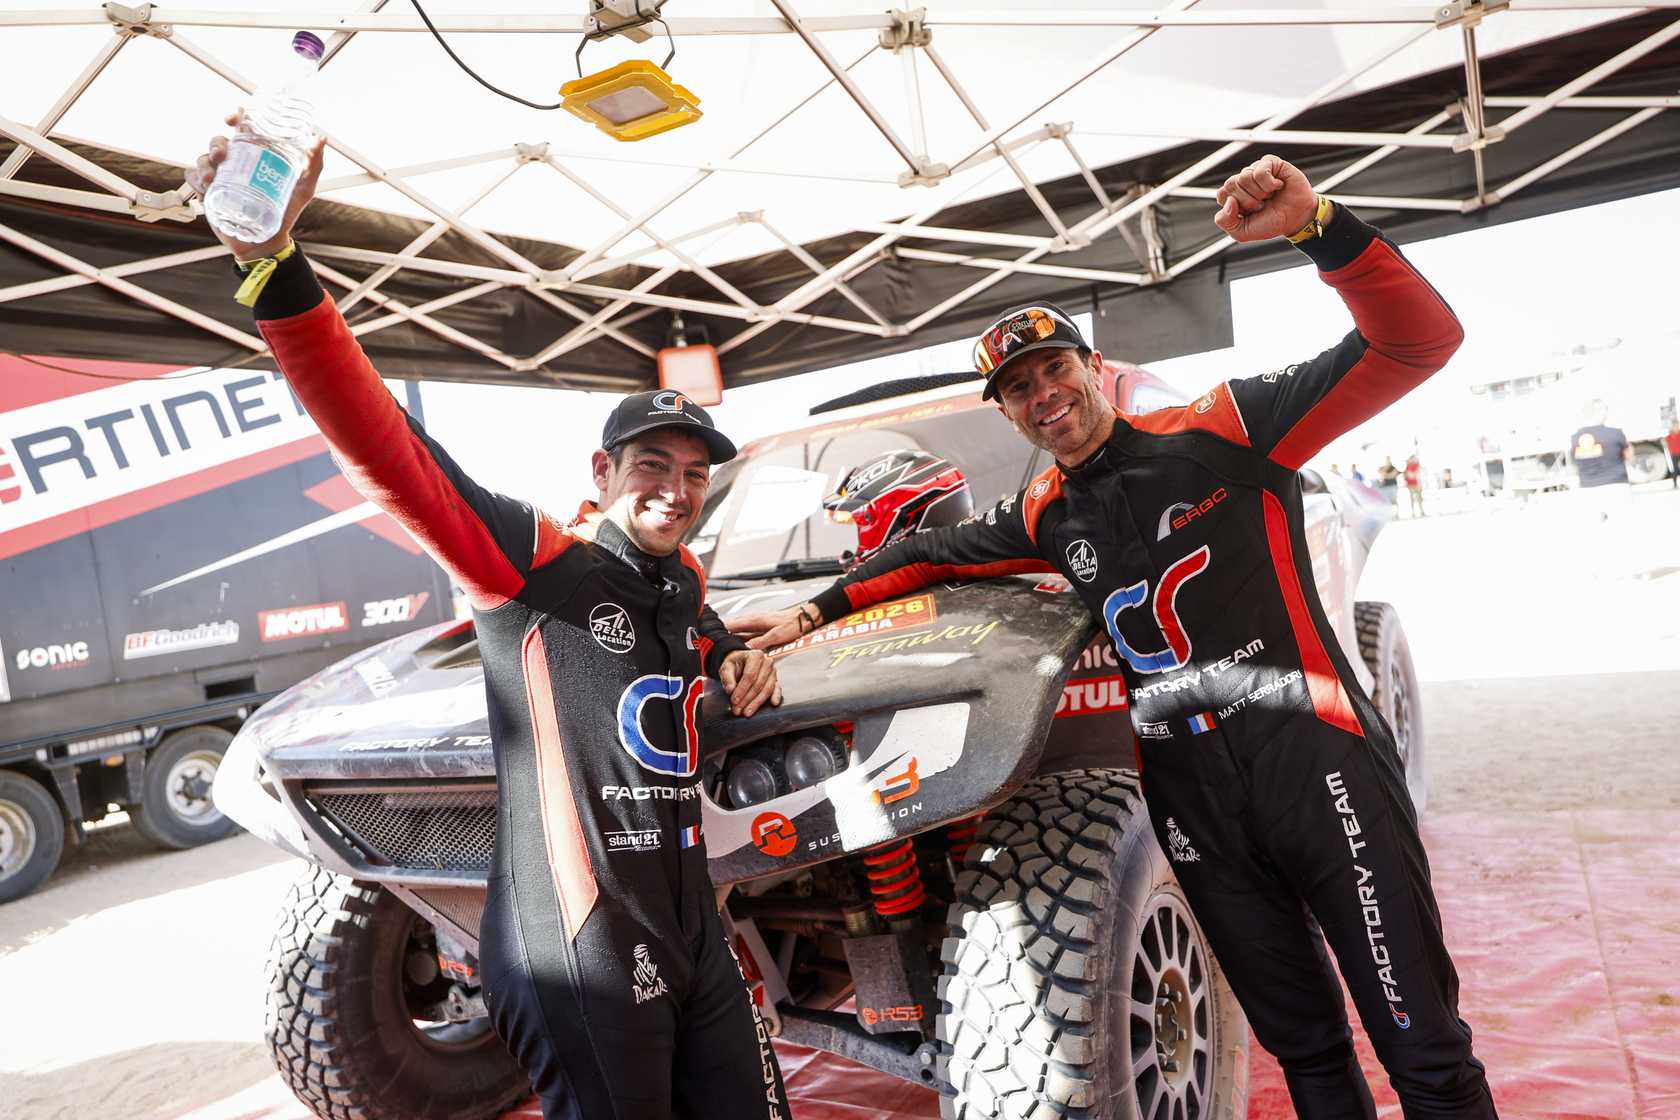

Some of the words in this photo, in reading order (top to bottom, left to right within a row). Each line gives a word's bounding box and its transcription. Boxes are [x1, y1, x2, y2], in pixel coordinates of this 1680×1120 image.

[1173, 487, 1228, 529] ERGO
[265, 606, 345, 638] MOTUL
[593, 623, 634, 641] DELTA
[810, 618, 894, 645] ARABIA
[846, 601, 925, 627] 2026
[1202, 638, 1265, 678] TEAM
[1217, 697, 1246, 720] MATT
[1247, 669, 1303, 703] SERRADORI
[1325, 770, 1367, 859] TEAM
[1353, 864, 1403, 1002] FACTORY
[632, 976, 669, 1005] DAKAR
